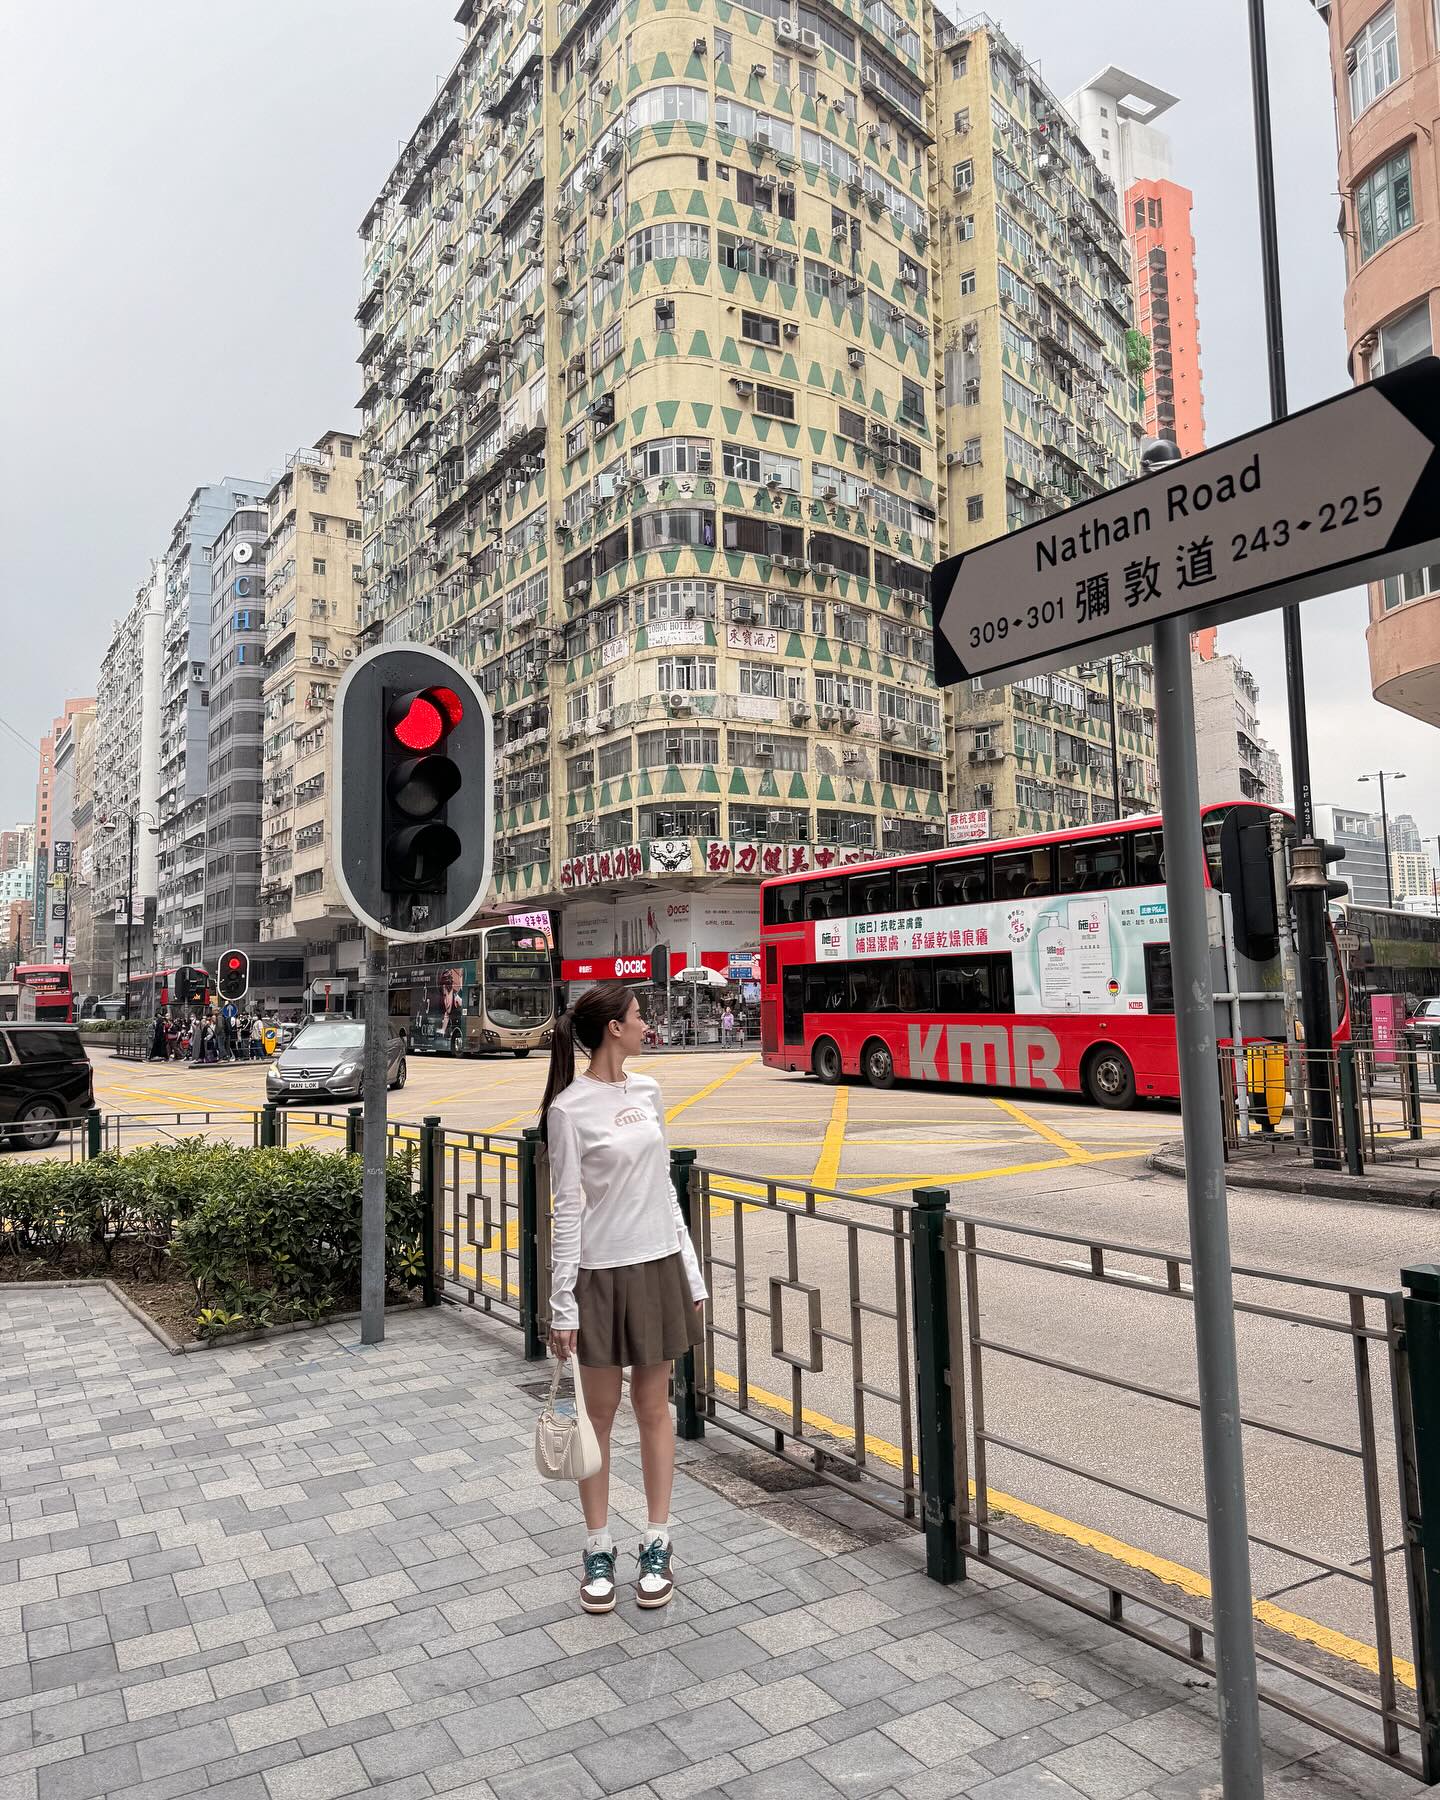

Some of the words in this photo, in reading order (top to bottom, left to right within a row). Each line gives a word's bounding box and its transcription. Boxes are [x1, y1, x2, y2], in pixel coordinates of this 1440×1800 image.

[1036, 507, 1151, 571] Nathan
[1167, 454, 1261, 522] Road
[969, 616, 1009, 648] 309
[1027, 597, 1064, 631] 301
[1075, 542, 1216, 624] 彌敦道
[1232, 520, 1290, 562] 243
[1318, 487, 1383, 533] 225
[670, 621, 692, 631] HOTEL
[37, 901, 45, 928] HOTEL
[673, 905, 689, 914] OCBC
[821, 933, 840, 948] 施巴
[623, 959, 647, 974] OCBC
[1129, 1002, 1144, 1010] KMB
[614, 1110, 648, 1127] emis
